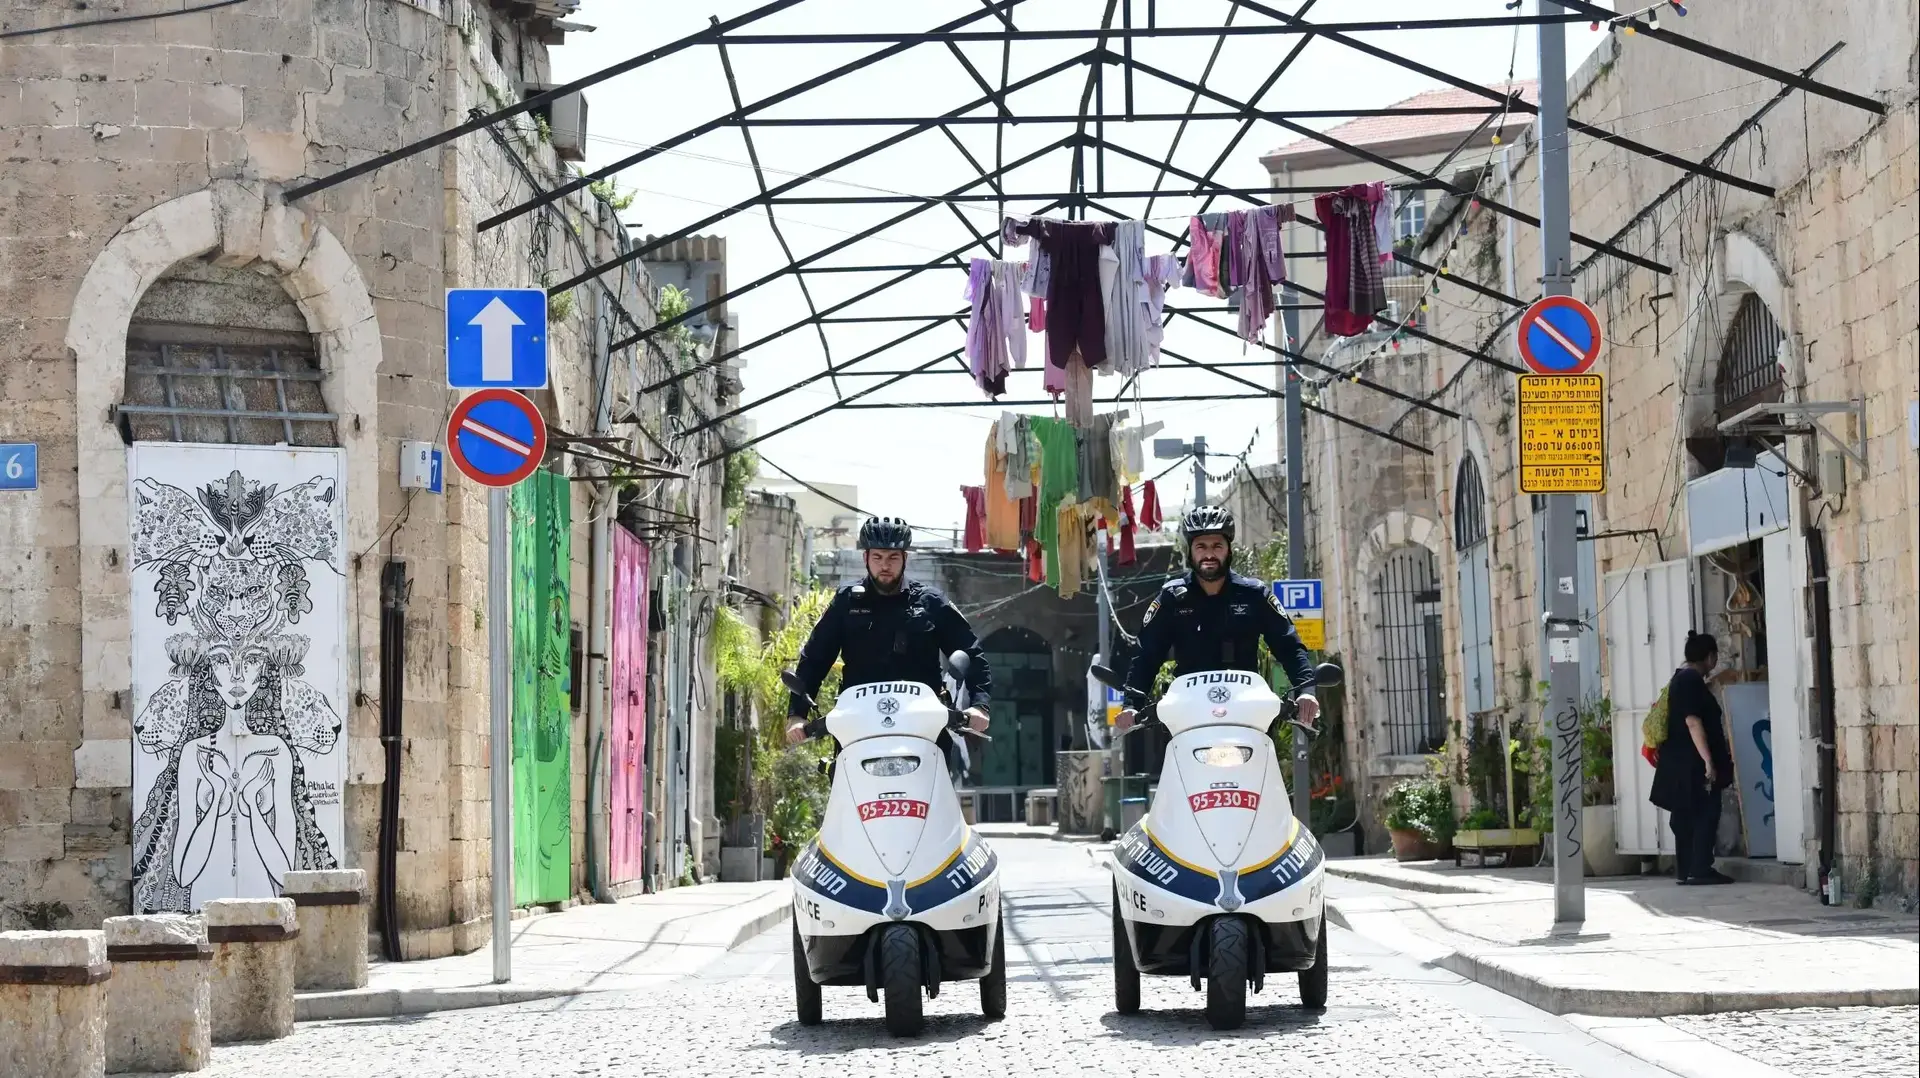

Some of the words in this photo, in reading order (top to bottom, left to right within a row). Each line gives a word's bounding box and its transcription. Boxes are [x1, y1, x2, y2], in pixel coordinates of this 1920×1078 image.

[1525, 377, 1547, 387] מטר
[1565, 377, 1596, 388] בתוקף
[1522, 390, 1550, 399] וטעינה
[1551, 390, 1575, 400] פריקה
[1576, 390, 1600, 399] מותרת
[1569, 428, 1599, 439] בימים
[1523, 441, 1549, 451] 10:00
[1550, 441, 1563, 451] עד
[1565, 441, 1593, 451] 06:00
[420, 450, 427, 461] 8
[6, 452, 23, 479] 6
[431, 459, 439, 484] 7
[1535, 468, 1565, 477] השעות
[1569, 467, 1590, 477] ביתר
[1186, 673, 1252, 688] משטרה
[855, 683, 921, 699] משטרה
[1128, 841, 1179, 885] משטרה
[1271, 837, 1314, 884] משטרה
[801, 853, 848, 896] משטרה
